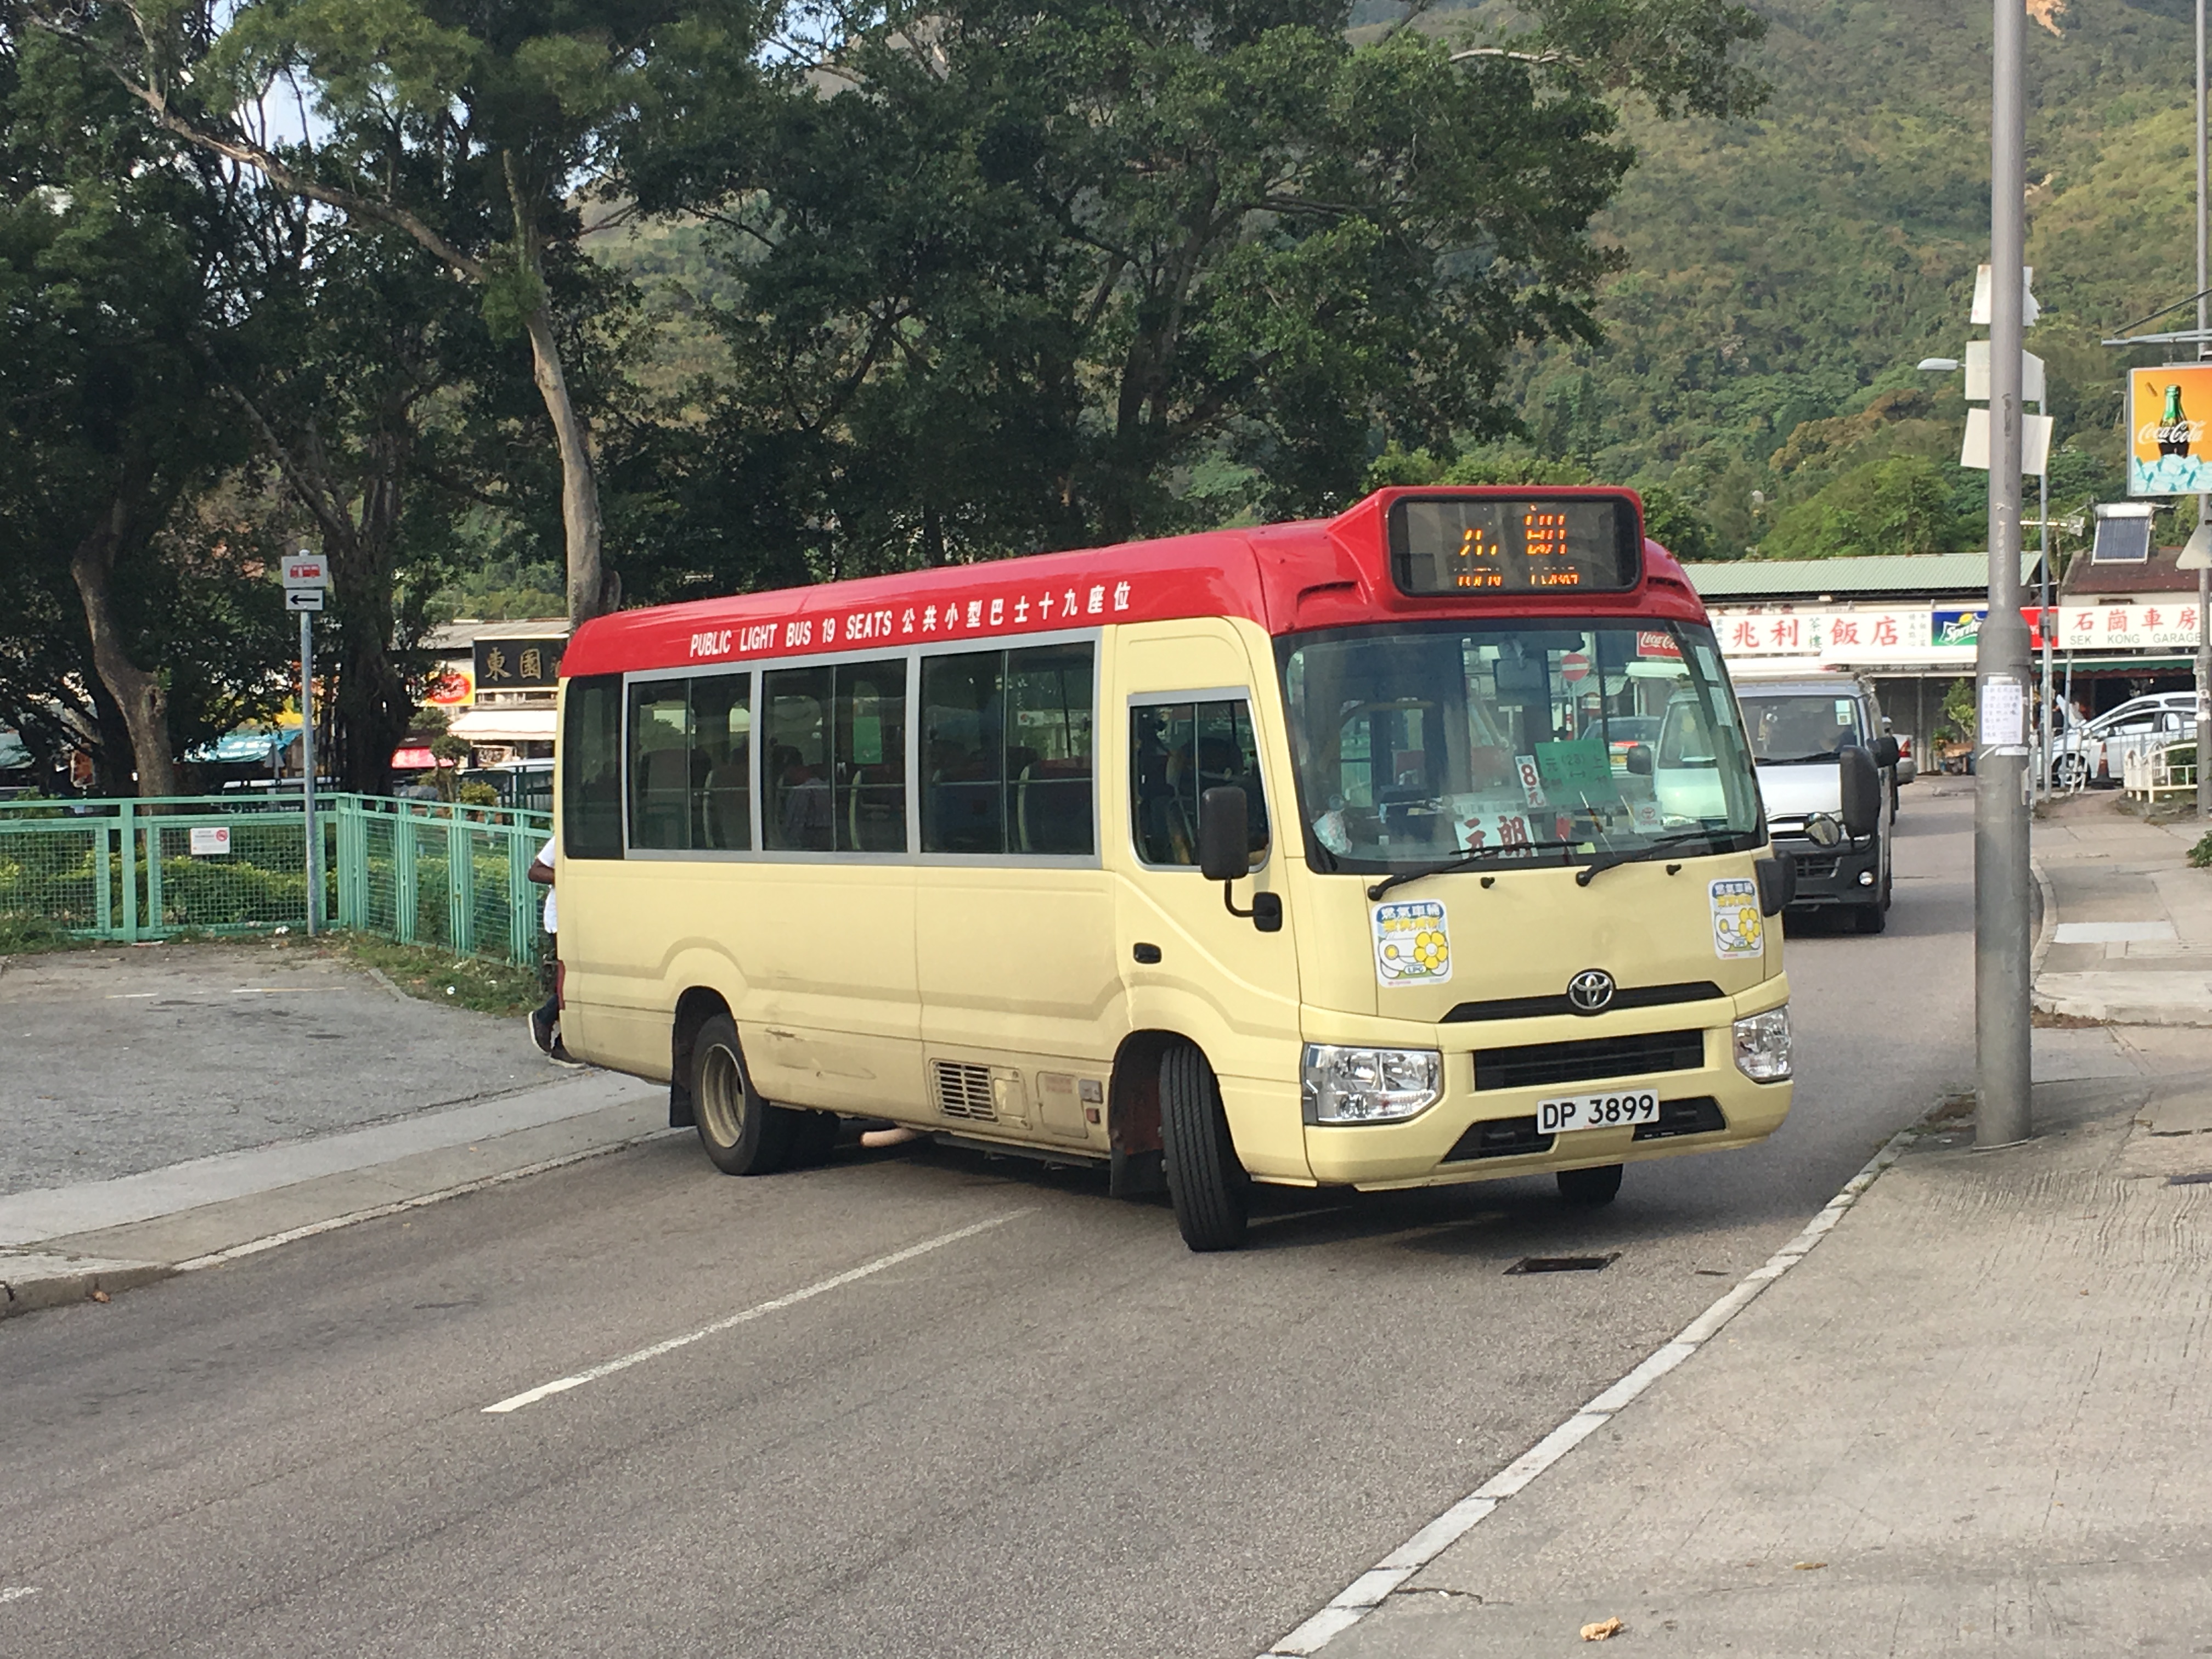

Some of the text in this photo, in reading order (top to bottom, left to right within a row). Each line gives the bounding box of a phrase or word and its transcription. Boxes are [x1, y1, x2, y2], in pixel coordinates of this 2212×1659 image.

[2138, 420, 2207, 444] Coca-Cola
[902, 580, 1131, 634] 公共小型巴士十九座位
[2072, 607, 2198, 632] 石崗車房
[690, 610, 893, 658] PUBLIC LIGHT BUS 19 SEATS
[1641, 631, 1678, 650] Coca-Co
[2070, 633, 2201, 645] SEK KONG GARAGE
[1543, 1094, 1654, 1129] DP 3899
